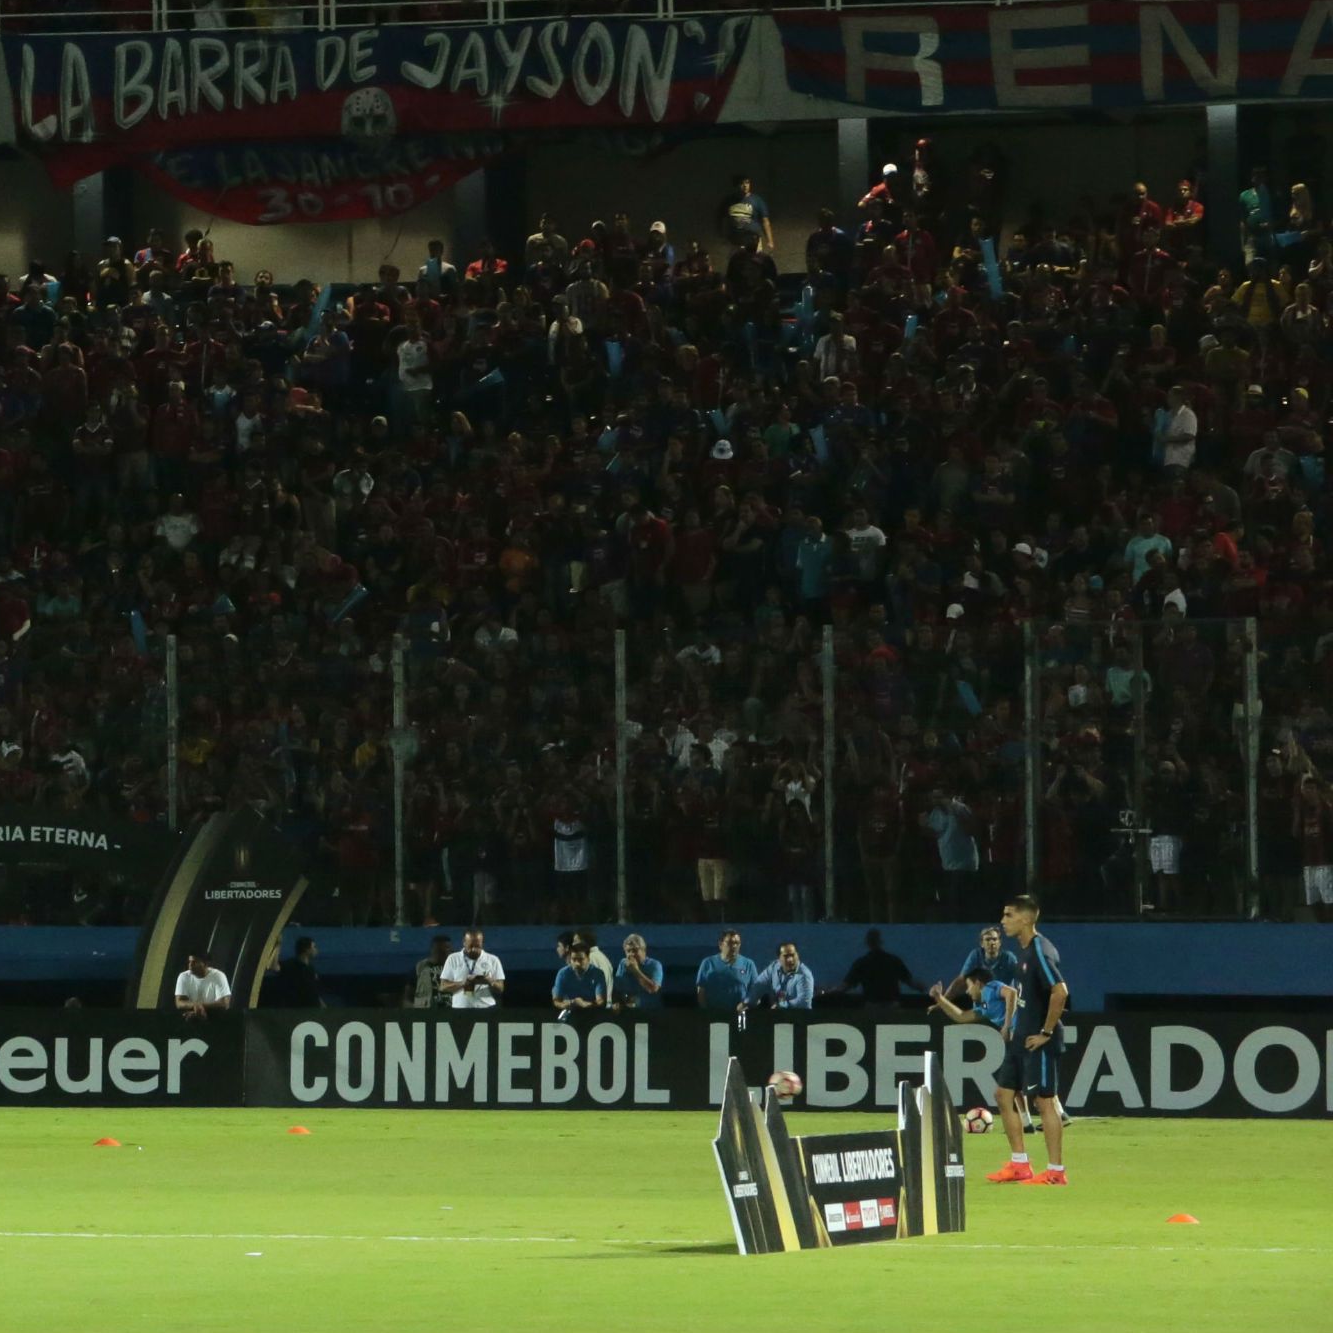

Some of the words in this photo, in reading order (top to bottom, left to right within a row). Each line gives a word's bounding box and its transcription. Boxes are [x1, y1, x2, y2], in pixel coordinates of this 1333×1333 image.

[19, 41, 95, 143] LA
[113, 34, 297, 129] BARRA
[316, 28, 379, 90] DE
[30, 825, 108, 851] ETERNA
[204, 889, 282, 900] LIBERTADORES
[289, 1021, 670, 1104] CONMEBOL
[708, 1022, 1333, 1113] LIBERADO
